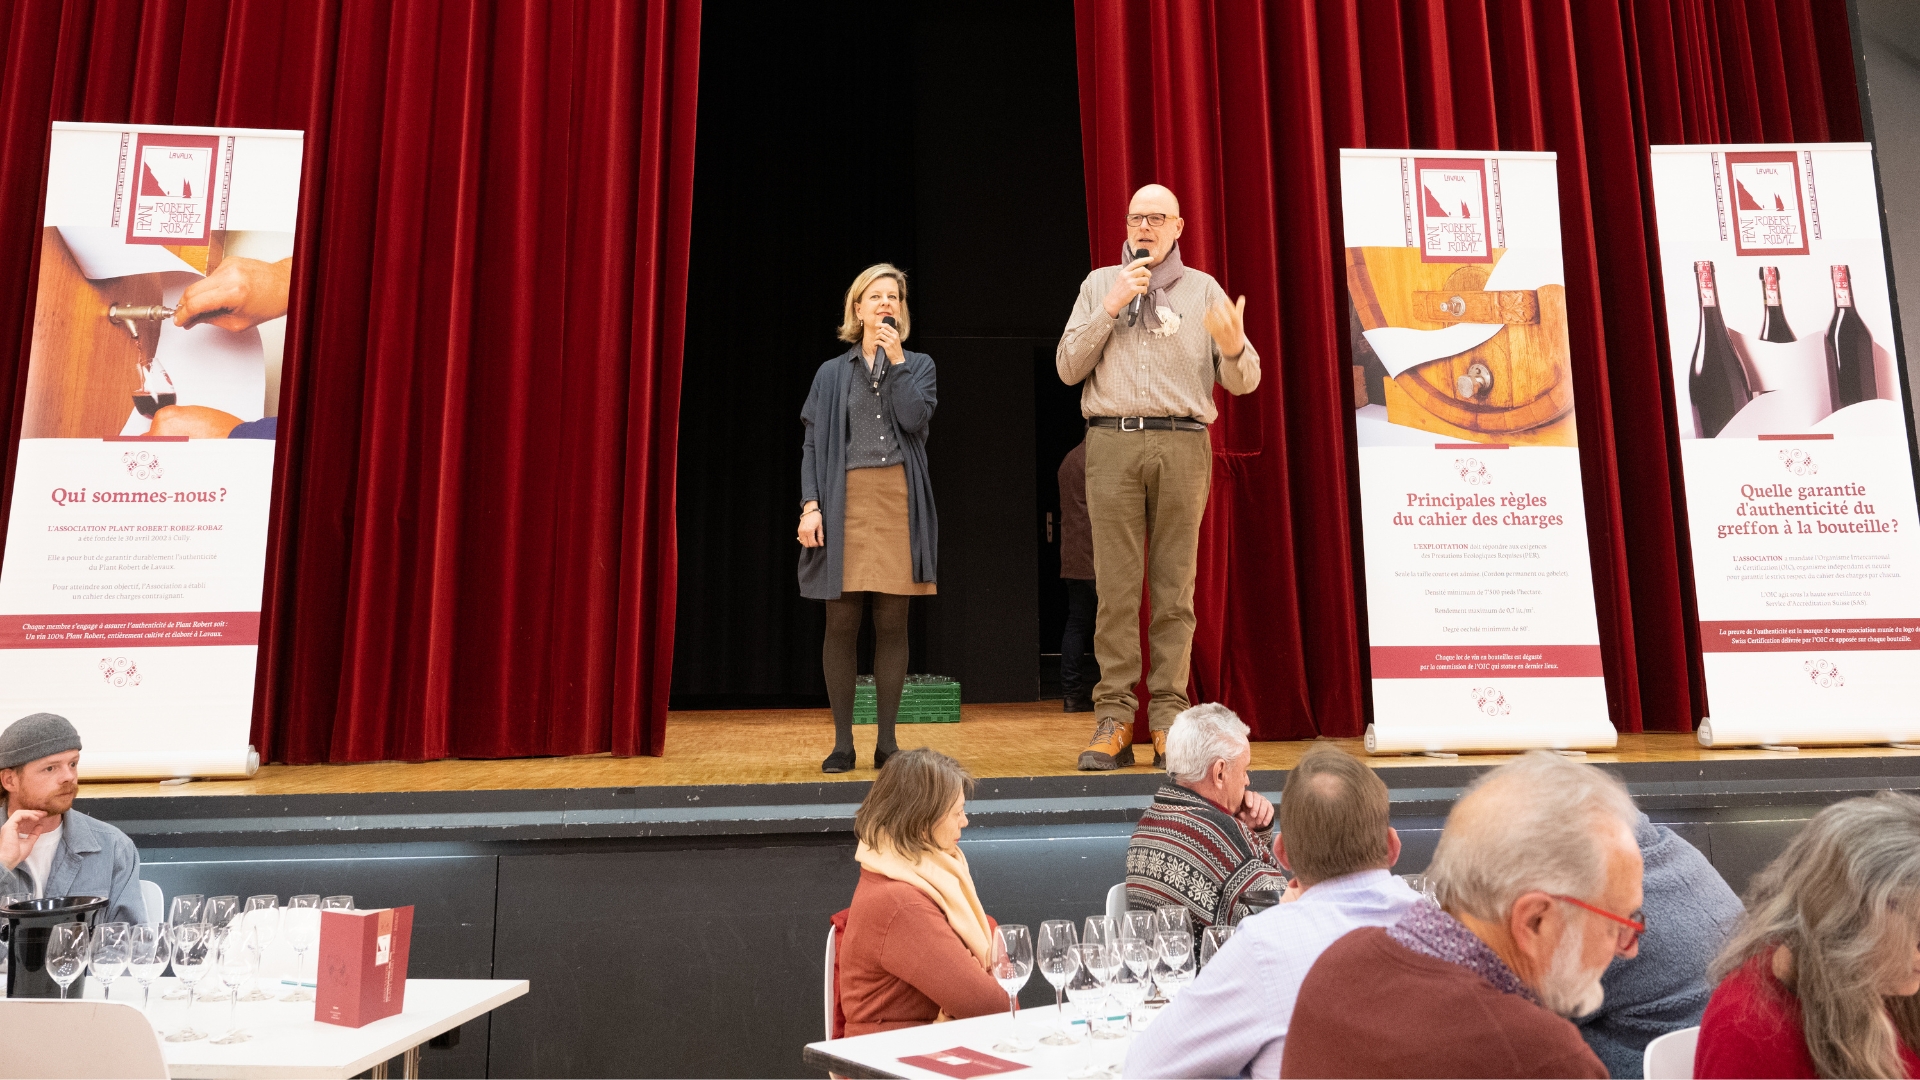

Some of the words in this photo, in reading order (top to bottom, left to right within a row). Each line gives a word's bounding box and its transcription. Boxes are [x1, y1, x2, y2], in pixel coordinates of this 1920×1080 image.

[168, 151, 194, 161] LAVAUX
[154, 202, 198, 214] ROBERT
[168, 213, 202, 223] ROBEZ
[1754, 215, 1792, 226] ROBERT
[1440, 222, 1477, 234] ROBERT
[1768, 225, 1798, 235] ROBEZ
[1453, 232, 1483, 242] ROBEZ
[51, 488, 86, 506] Qui
[1741, 484, 1792, 501] Quelle
[1798, 482, 1866, 501] garantie
[1407, 493, 1495, 510] Principales
[1500, 492, 1547, 510] règles
[1736, 500, 1848, 516] d'authenticité
[1853, 501, 1875, 514] du
[1393, 512, 1413, 525] du
[1418, 512, 1467, 526] cahier
[1472, 512, 1498, 526] des
[1503, 512, 1563, 529] charges
[1718, 521, 1779, 538] greffon
[1797, 521, 1812, 534] la
[22, 623, 45, 631] Chaque
